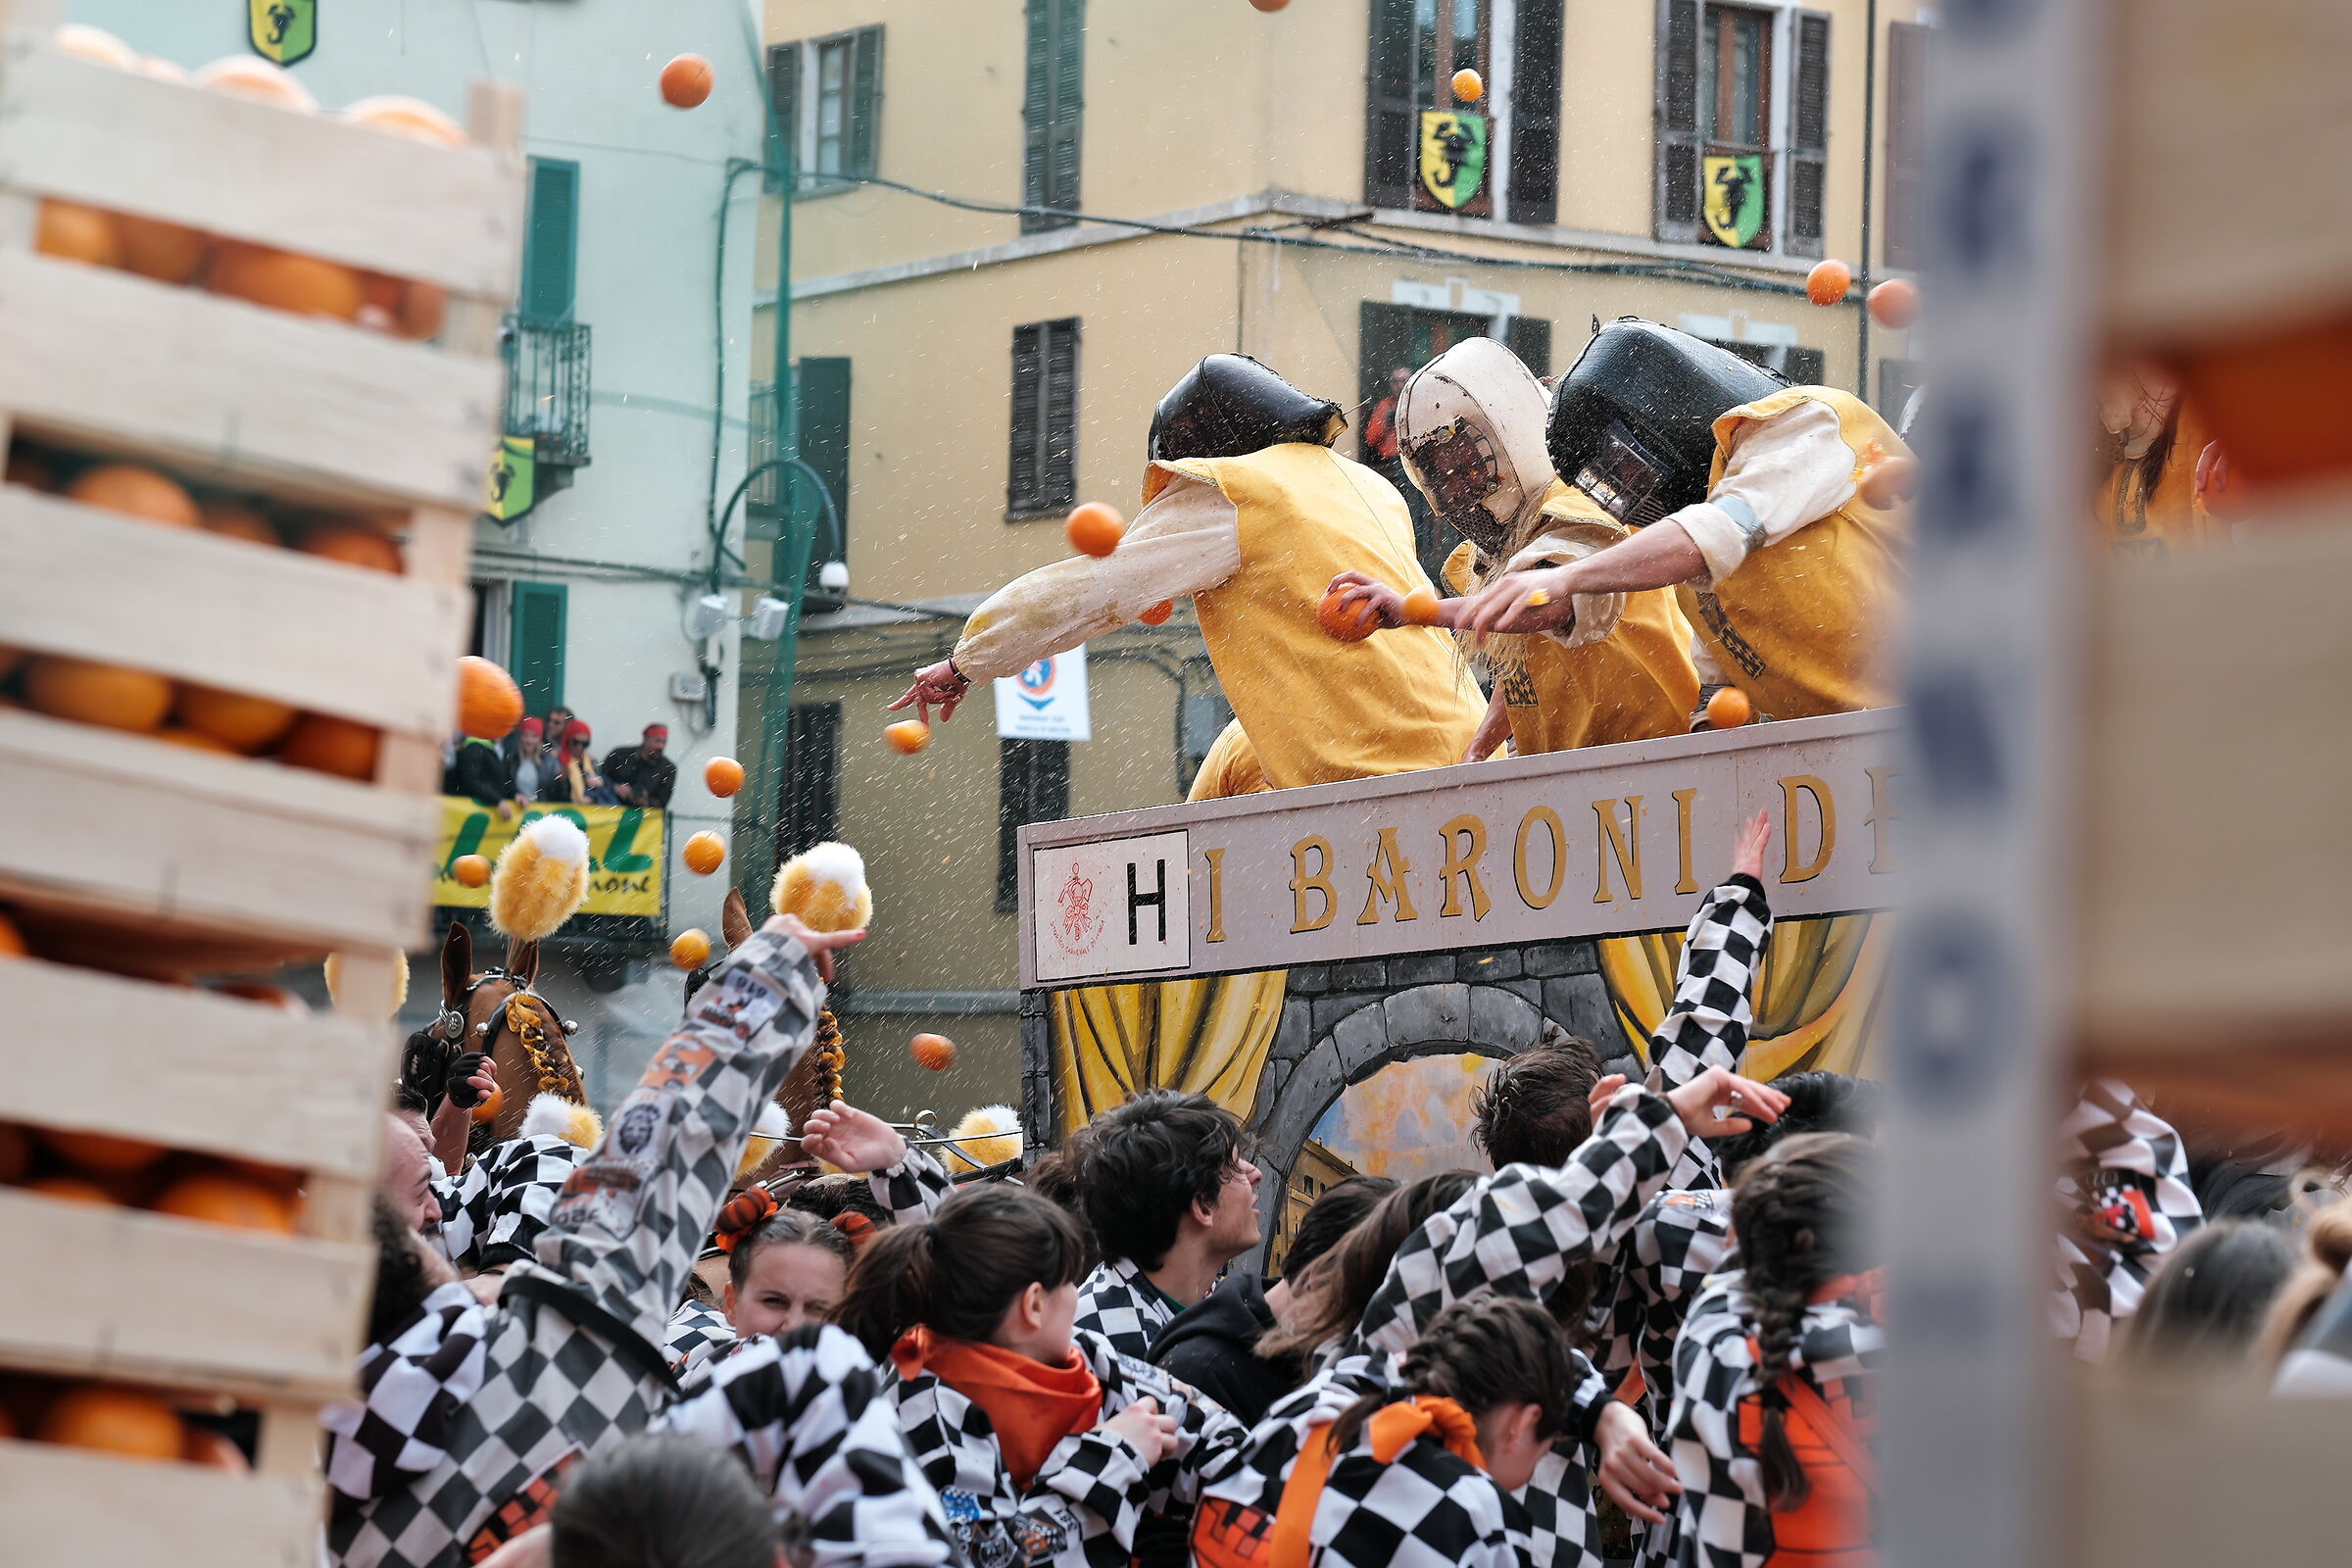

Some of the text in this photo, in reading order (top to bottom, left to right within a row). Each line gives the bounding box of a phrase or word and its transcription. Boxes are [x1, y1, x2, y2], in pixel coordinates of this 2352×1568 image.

[1127, 858, 1165, 945] H
[1204, 847, 1227, 943] I
[1290, 787, 1700, 934] BARONI
